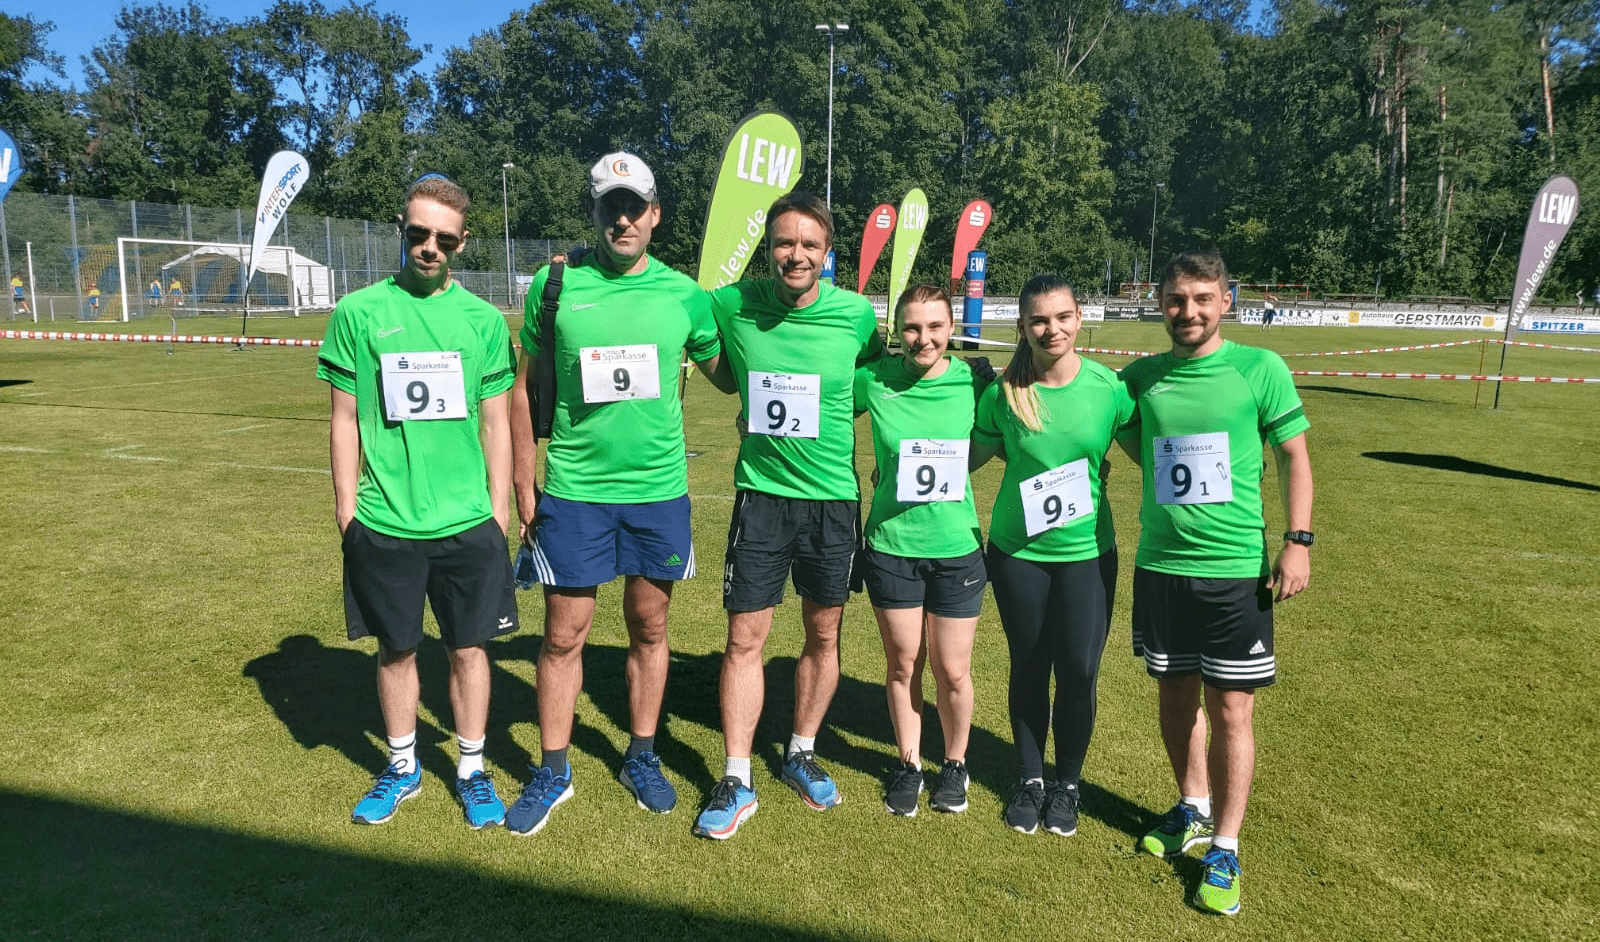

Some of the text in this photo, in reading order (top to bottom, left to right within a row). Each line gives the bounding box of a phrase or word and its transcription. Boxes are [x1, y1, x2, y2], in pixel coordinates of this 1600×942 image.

[737, 133, 796, 189] LEW
[263, 163, 302, 216] INTERSPORT
[272, 182, 296, 219] WOLF
[903, 203, 926, 229] LEW
[1538, 192, 1576, 225] LEW
[1510, 238, 1557, 326] www.lew.de
[1394, 313, 1482, 327] GERSTMAYR
[1532, 321, 1585, 331] SPITZER
[411, 363, 449, 371] Sparkasse
[602, 352, 647, 362] Sparkasse
[613, 367, 631, 392] 9
[773, 383, 807, 391] Sparkasse
[406, 380, 446, 414] 9 3
[766, 399, 801, 432] 9 2
[923, 448, 957, 456] Sparkasse
[1175, 444, 1213, 453] Sparkasse
[915, 464, 949, 496] 9 4
[1044, 472, 1076, 487] Sparkasse
[1170, 463, 1210, 498] 9 1
[1042, 494, 1076, 525] 9 5
